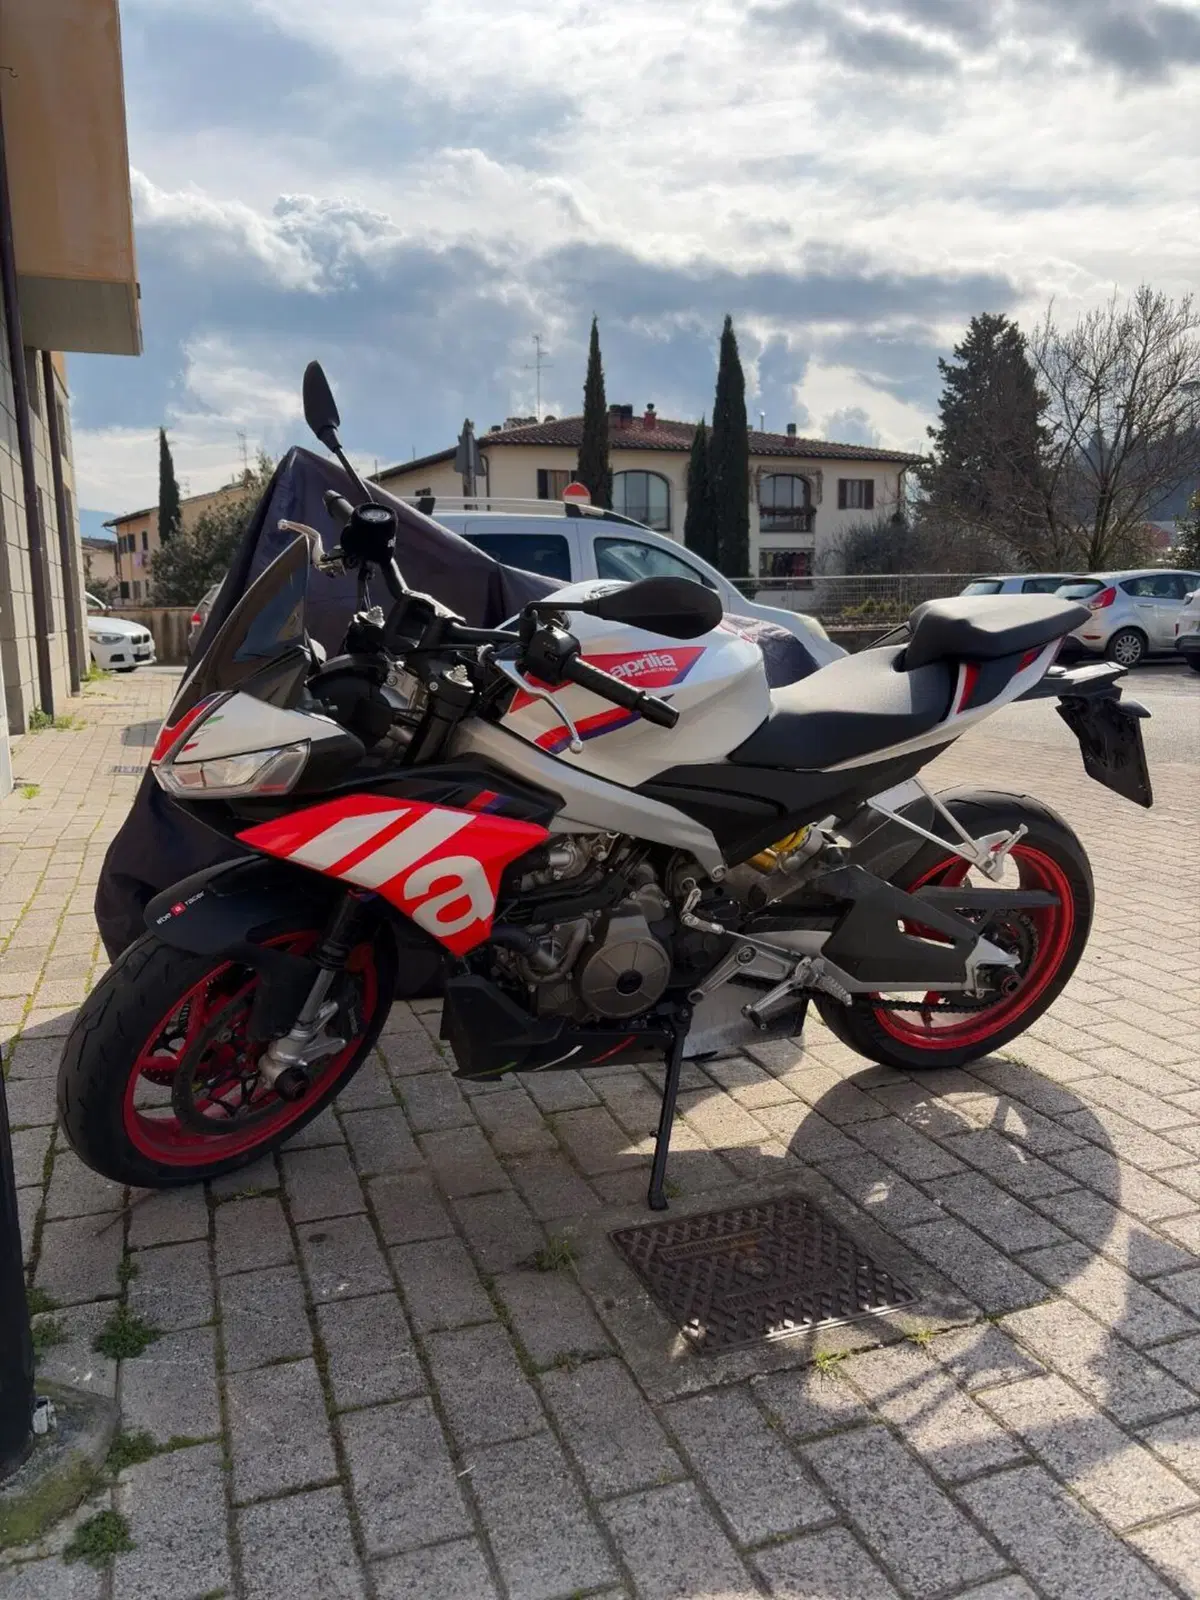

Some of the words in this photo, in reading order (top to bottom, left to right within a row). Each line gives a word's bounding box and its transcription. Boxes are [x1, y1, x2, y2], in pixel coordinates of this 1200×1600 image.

[609, 652, 676, 678] aprilia
[184, 891, 204, 905] racer
[403, 855, 495, 937] a
